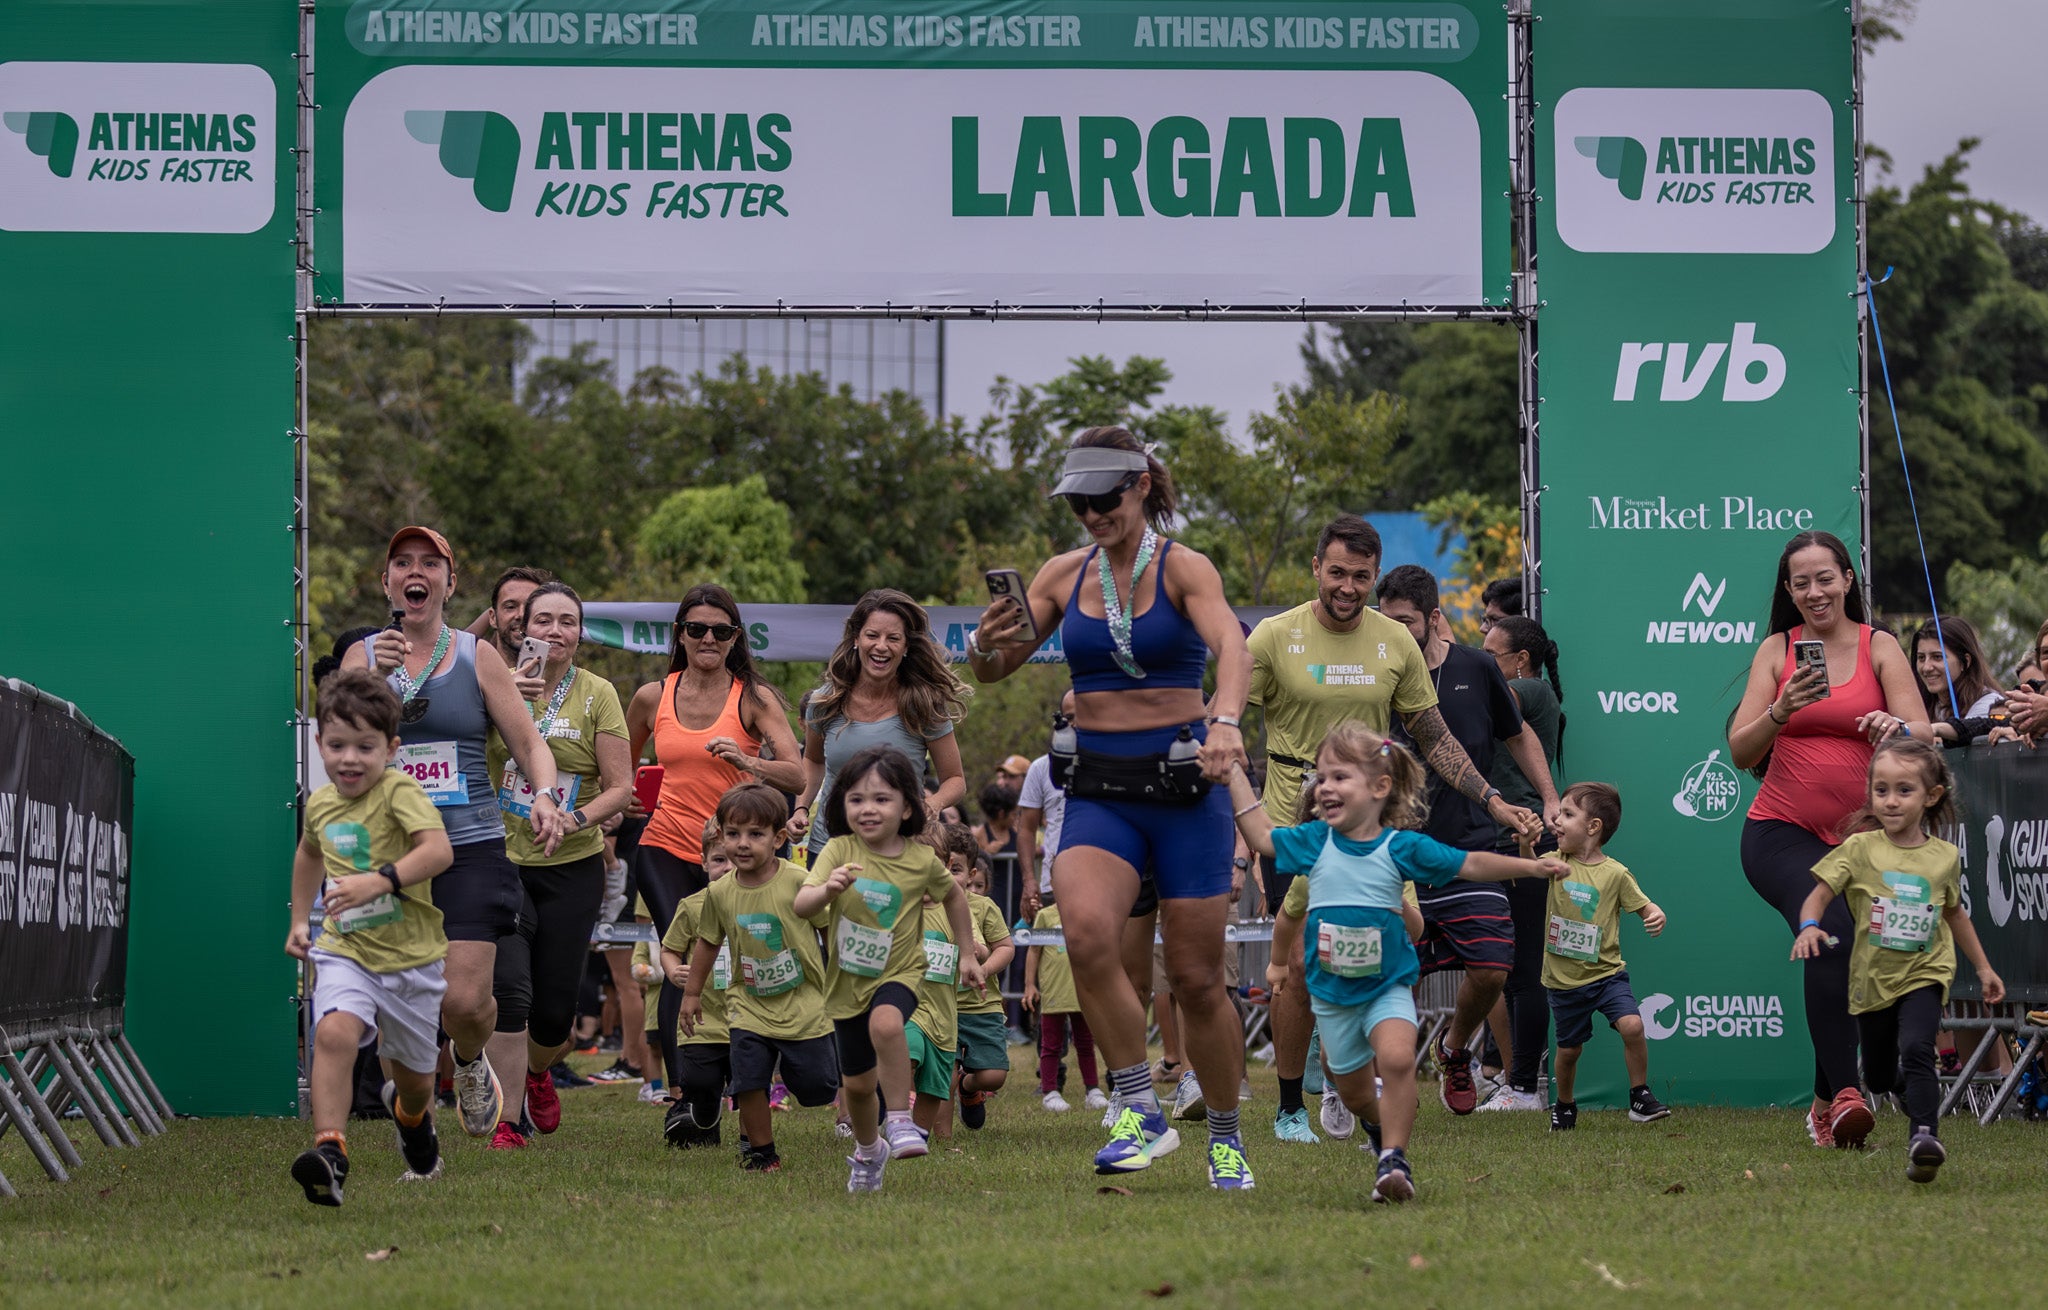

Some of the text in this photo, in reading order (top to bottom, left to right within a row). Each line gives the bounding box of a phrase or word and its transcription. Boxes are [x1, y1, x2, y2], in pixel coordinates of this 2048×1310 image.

[364, 10, 698, 46] ATHENAS KIDS FASTER
[751, 14, 1081, 47] ATHENAS KIDS FASTER
[1133, 15, 1461, 49] ATHENAS KIDS FASTER
[88, 112, 256, 152] ATHENAS
[534, 111, 793, 172] ATHENAS
[951, 115, 1416, 218] LARGADA
[1656, 136, 1816, 175] ATHENAS
[88, 157, 254, 183] KIDS FASTER
[535, 181, 790, 219] KIDS FASTER
[1657, 180, 1815, 205] KIDS FASTER
[1612, 322, 1787, 402] rvb
[1588, 496, 1813, 530] Market Place
[1646, 621, 1756, 643] NEWON
[1326, 664, 1364, 674] ATHENAS
[1326, 674, 1376, 685] RUN FASTER
[1597, 691, 1679, 713] VIGOR
[403, 761, 450, 781] 2841
[1706, 771, 1723, 781] 92.5
[1706, 780, 1736, 796] KISS
[1706, 796, 1726, 811] FM
[1888, 912, 1930, 933] 9256
[845, 936, 888, 962] 9282
[1336, 940, 1379, 957] 9224
[1561, 929, 1594, 947] 9231
[756, 959, 794, 981] 9258
[1684, 995, 1784, 1016] IGUANA
[1684, 1017, 1784, 1038] SPORTS
